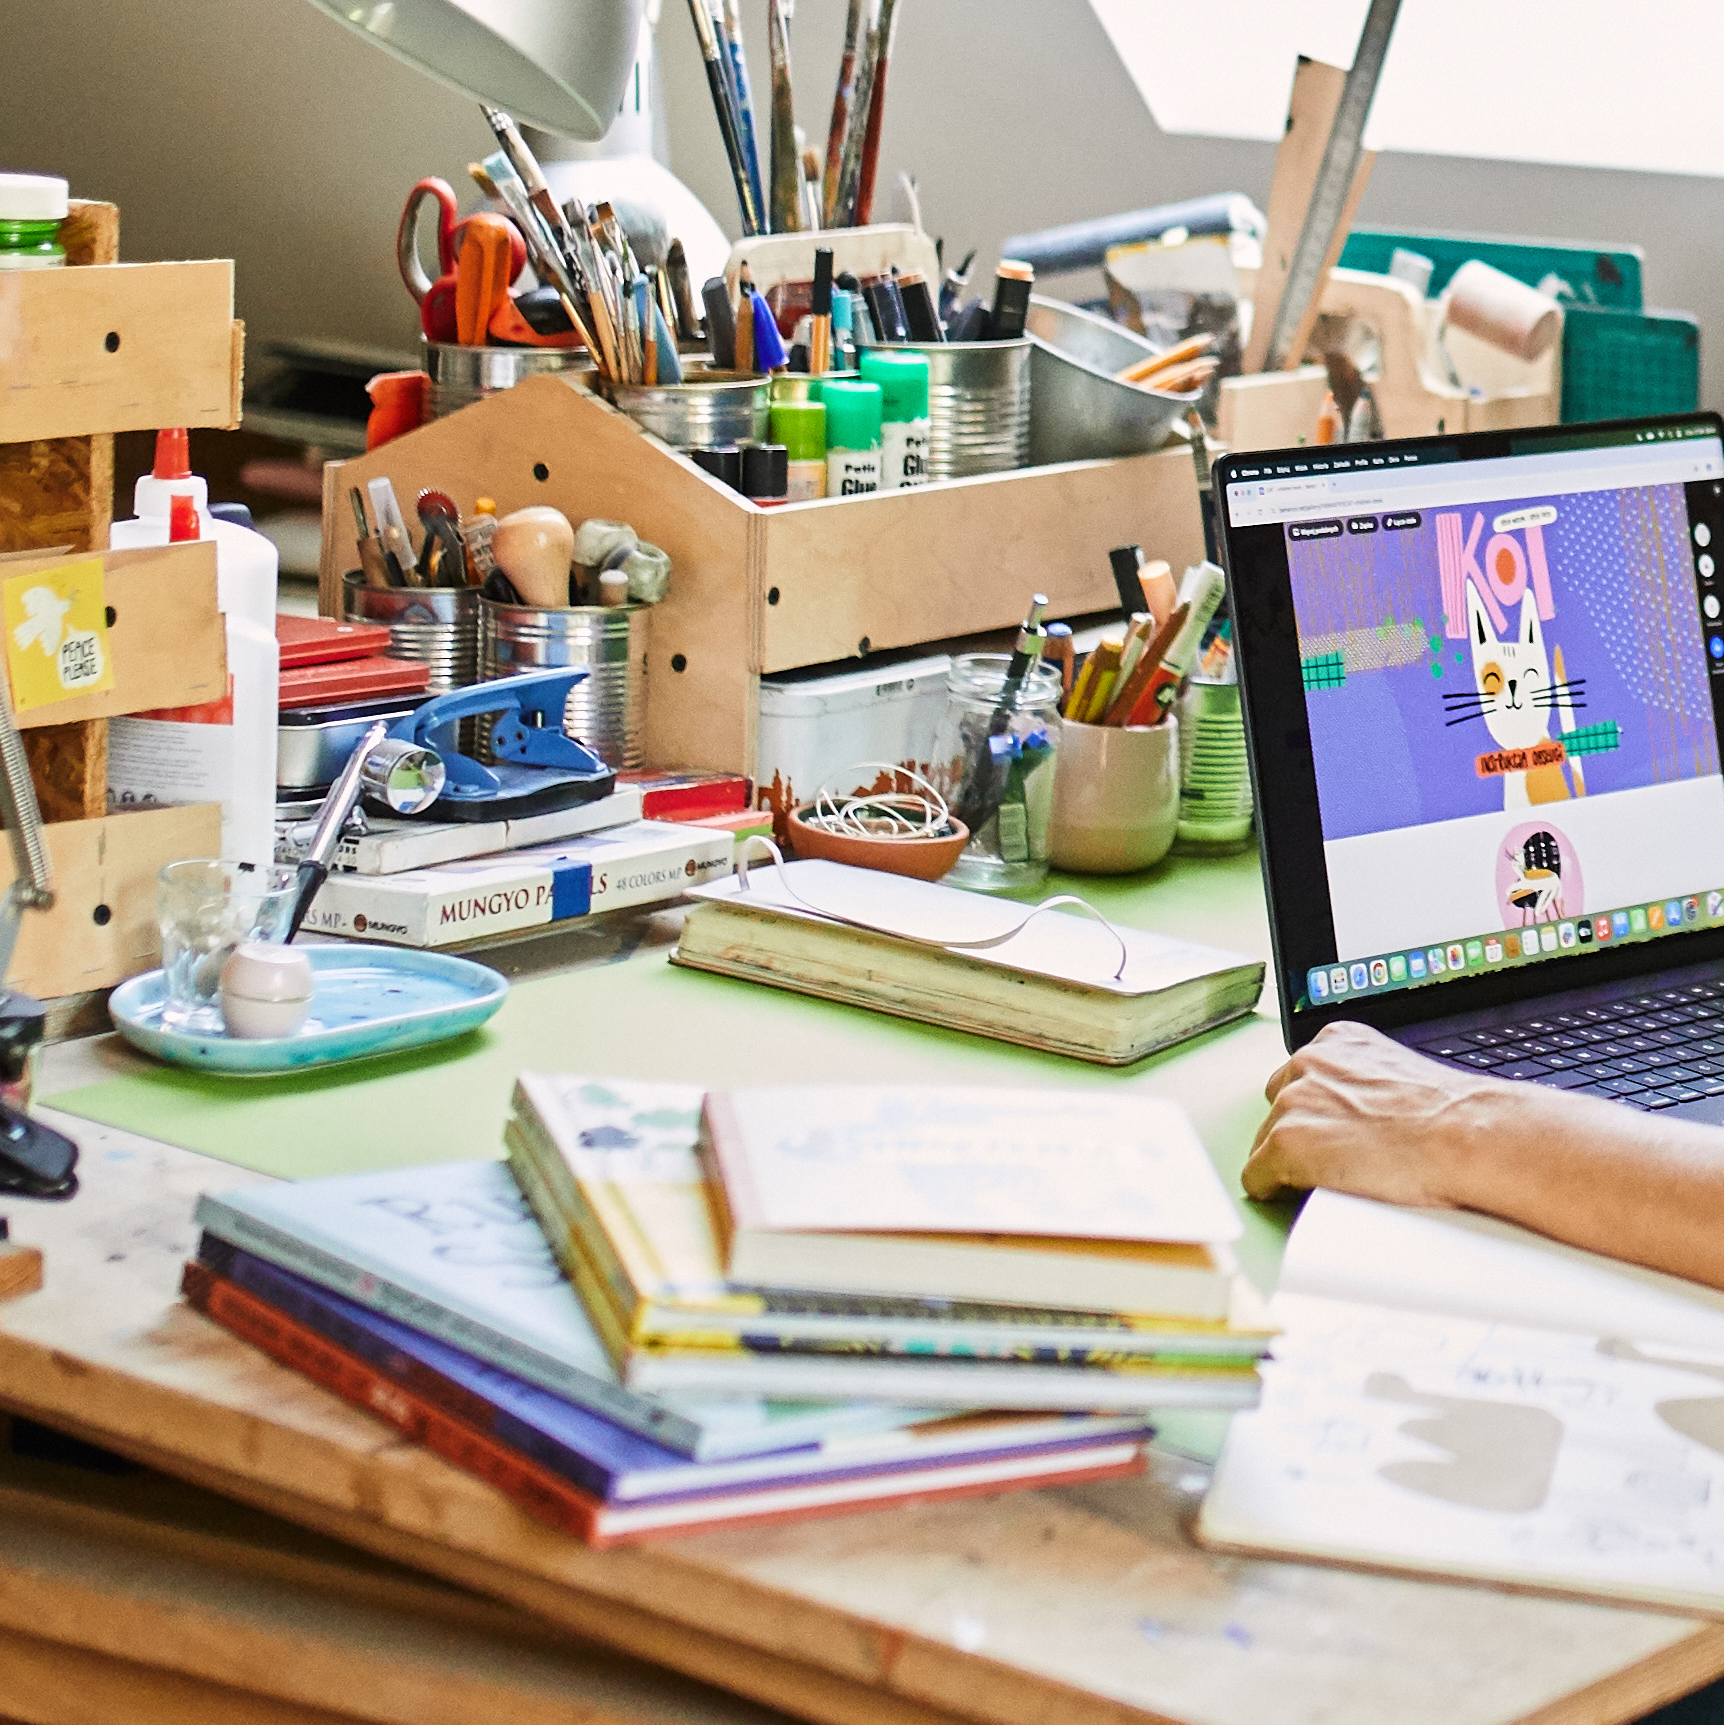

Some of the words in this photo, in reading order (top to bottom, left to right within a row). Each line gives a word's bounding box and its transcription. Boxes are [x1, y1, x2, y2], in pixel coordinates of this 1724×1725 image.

[62, 636, 96, 665] PEACE
[63, 657, 98, 683] PLEASE
[628, 869, 667, 889] COLORS
[440, 887, 530, 925] MUNGYO
